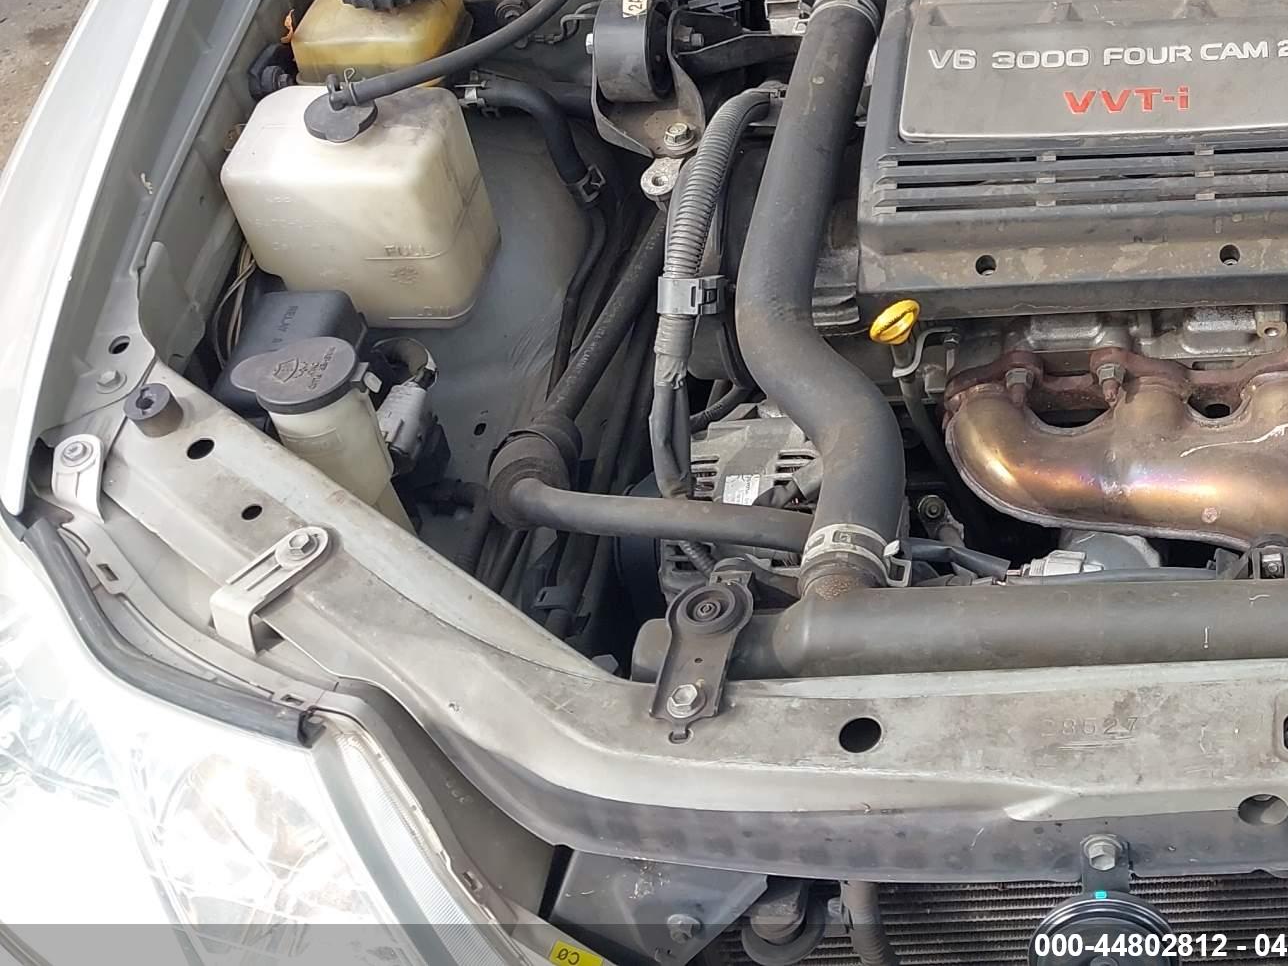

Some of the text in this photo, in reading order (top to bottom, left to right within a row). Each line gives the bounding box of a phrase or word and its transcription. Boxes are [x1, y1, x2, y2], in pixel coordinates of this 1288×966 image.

[928, 48, 977, 70] V6
[991, 48, 1090, 70] 3000
[1103, 44, 1192, 66] FOUR
[1200, 41, 1270, 61] CAM
[1063, 86, 1191, 114] VVT-i
[384, 243, 431, 256] FULL
